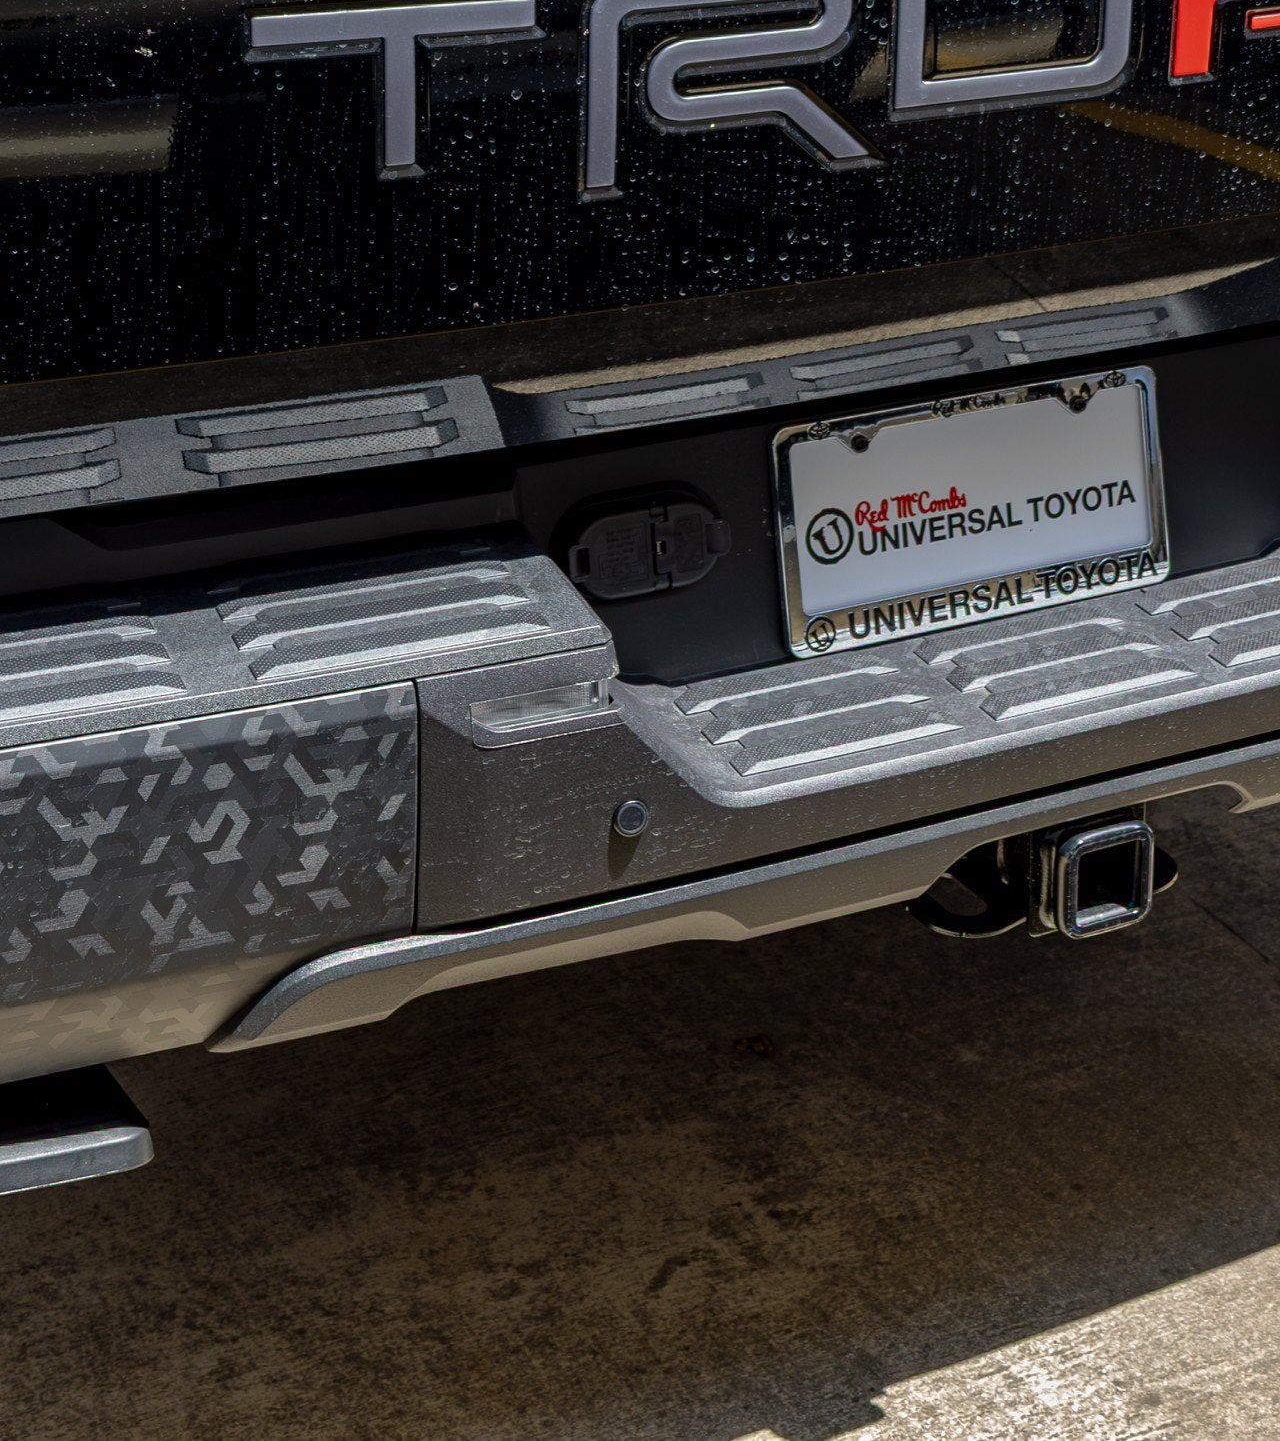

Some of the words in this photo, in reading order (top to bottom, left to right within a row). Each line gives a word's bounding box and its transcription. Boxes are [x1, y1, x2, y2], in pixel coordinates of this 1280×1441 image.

[854, 498, 889, 533] Red
[890, 486, 967, 519] McCombs
[857, 502, 1023, 556] UNIVERSAL
[1026, 479, 1136, 523] TOYOTA
[847, 577, 1035, 640] UNIVERSAL
[1037, 549, 1159, 599] TOYOTA
